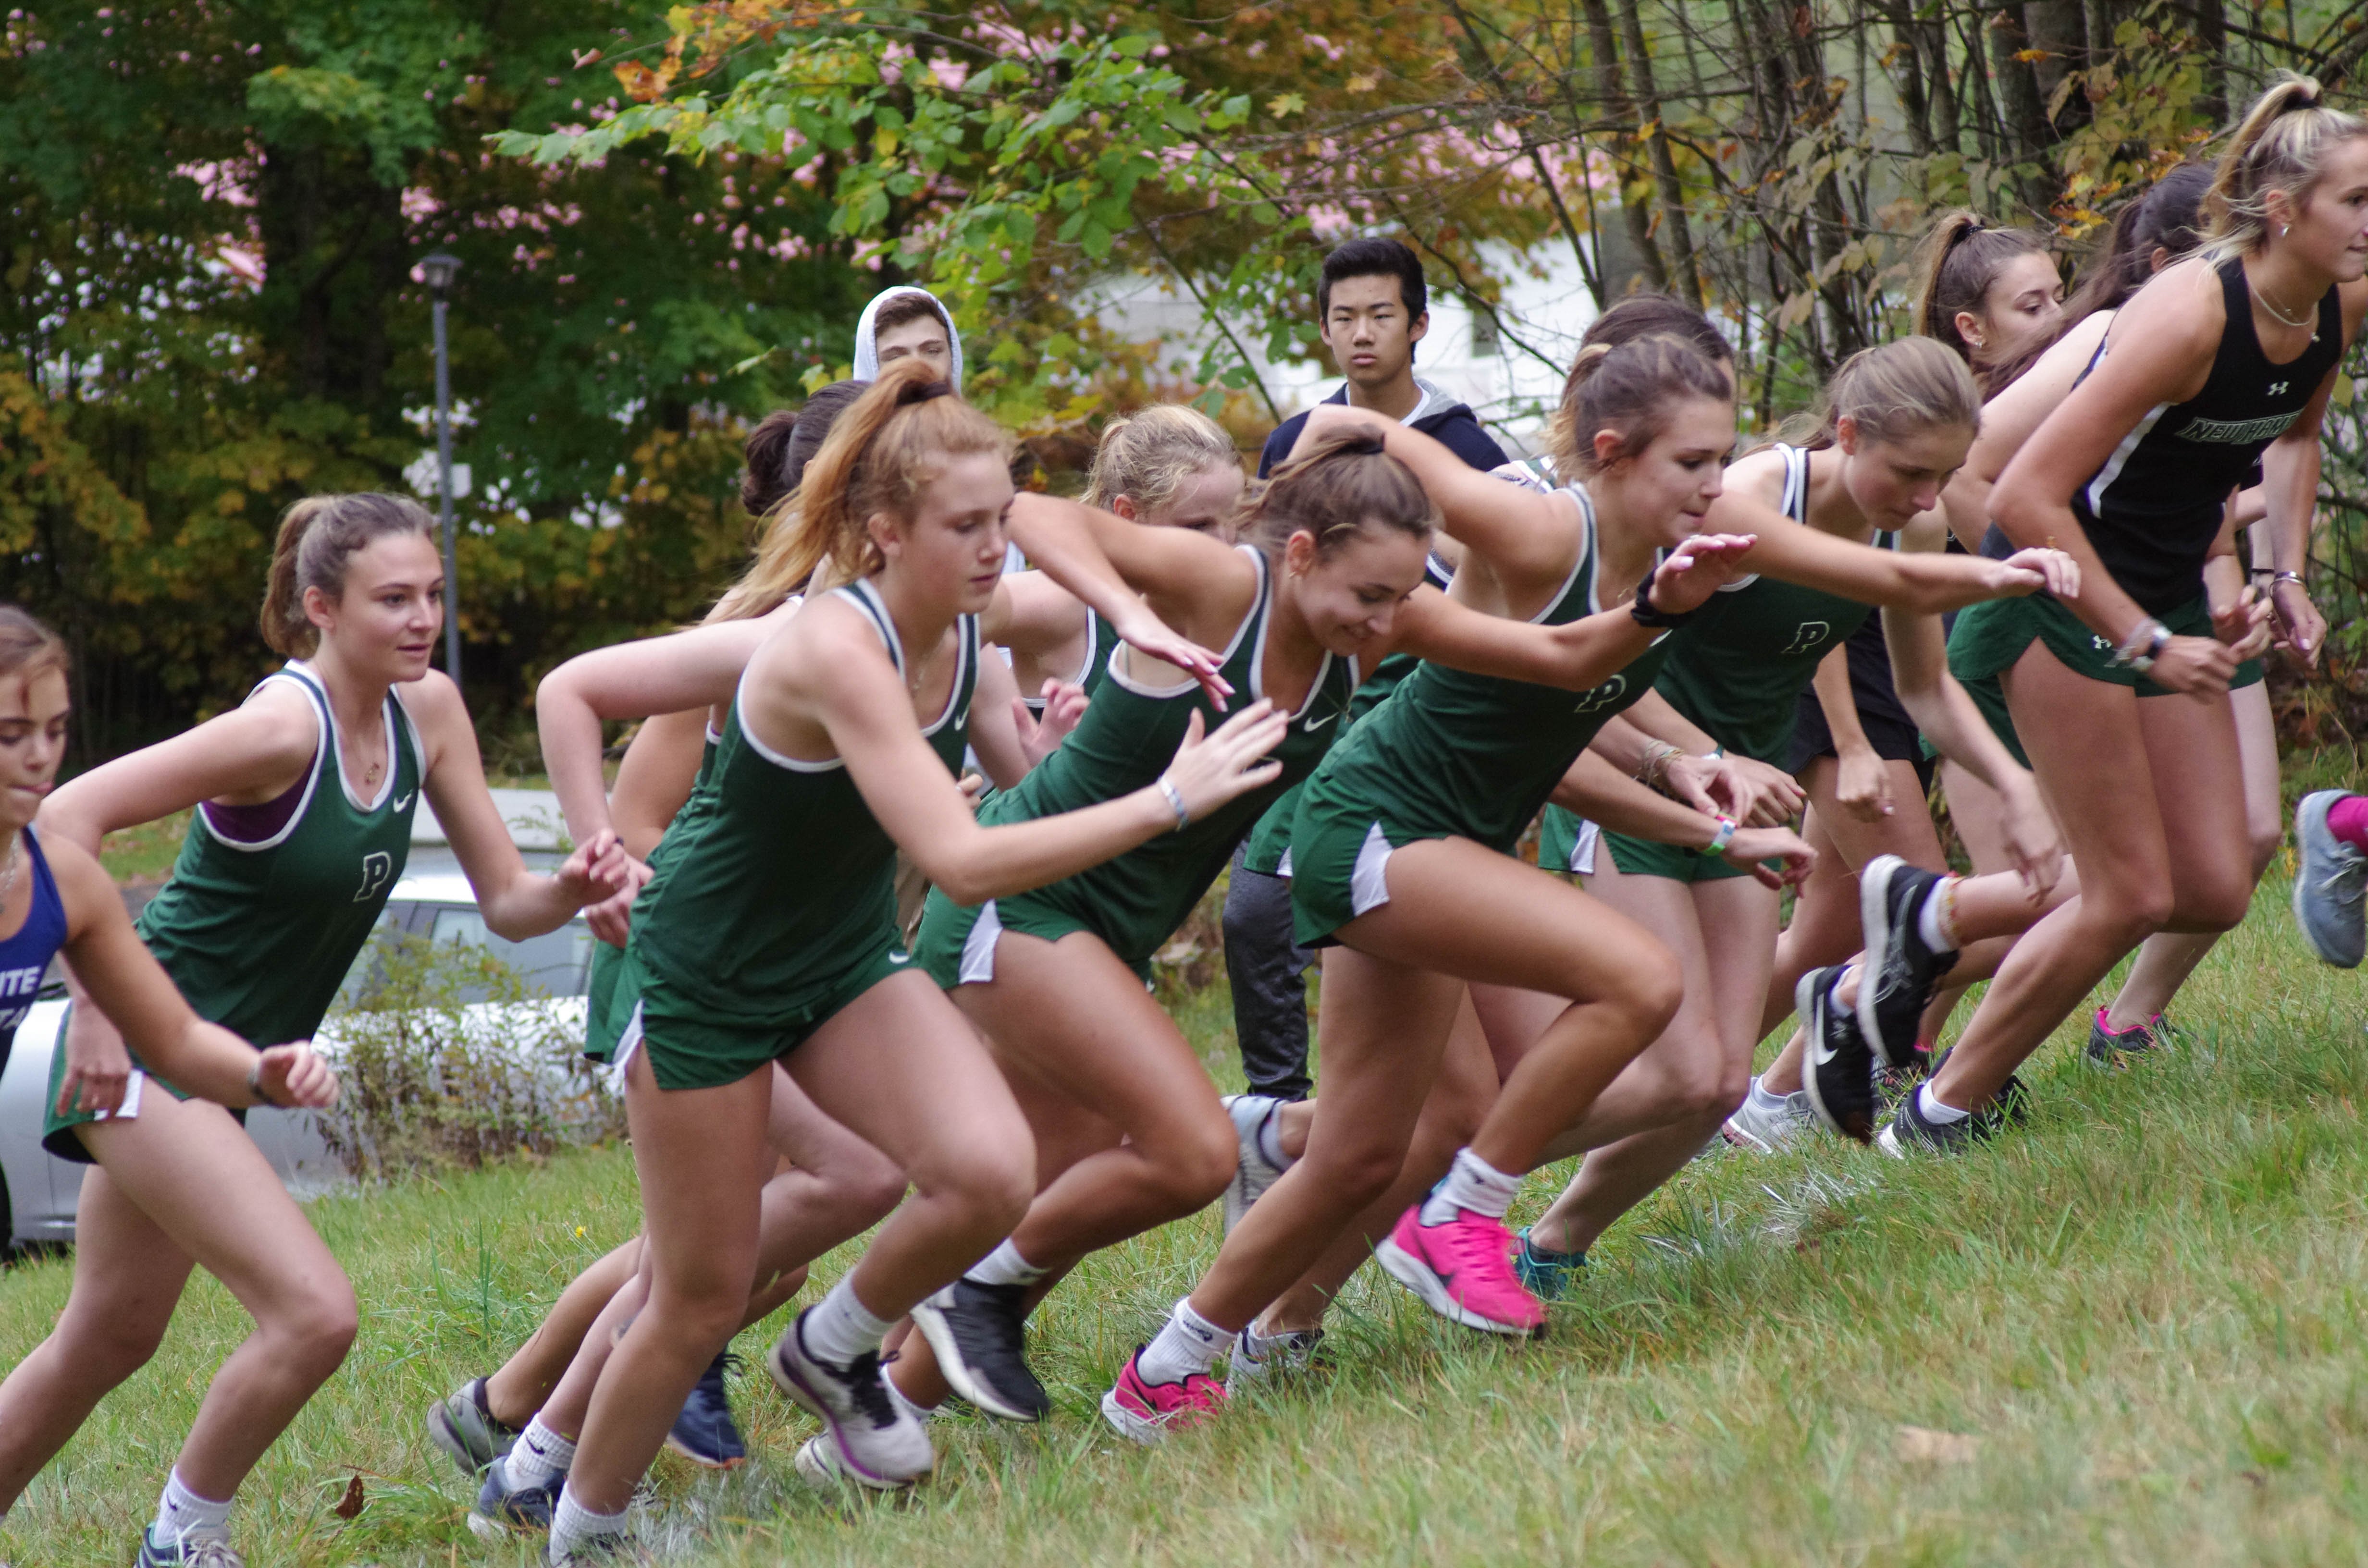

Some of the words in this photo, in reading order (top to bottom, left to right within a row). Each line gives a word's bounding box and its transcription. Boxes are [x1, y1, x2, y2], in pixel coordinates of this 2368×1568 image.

[2179, 418, 2250, 442] NEW
[1780, 621, 1830, 654] P
[1574, 674, 1627, 712] P
[353, 850, 392, 902] P
